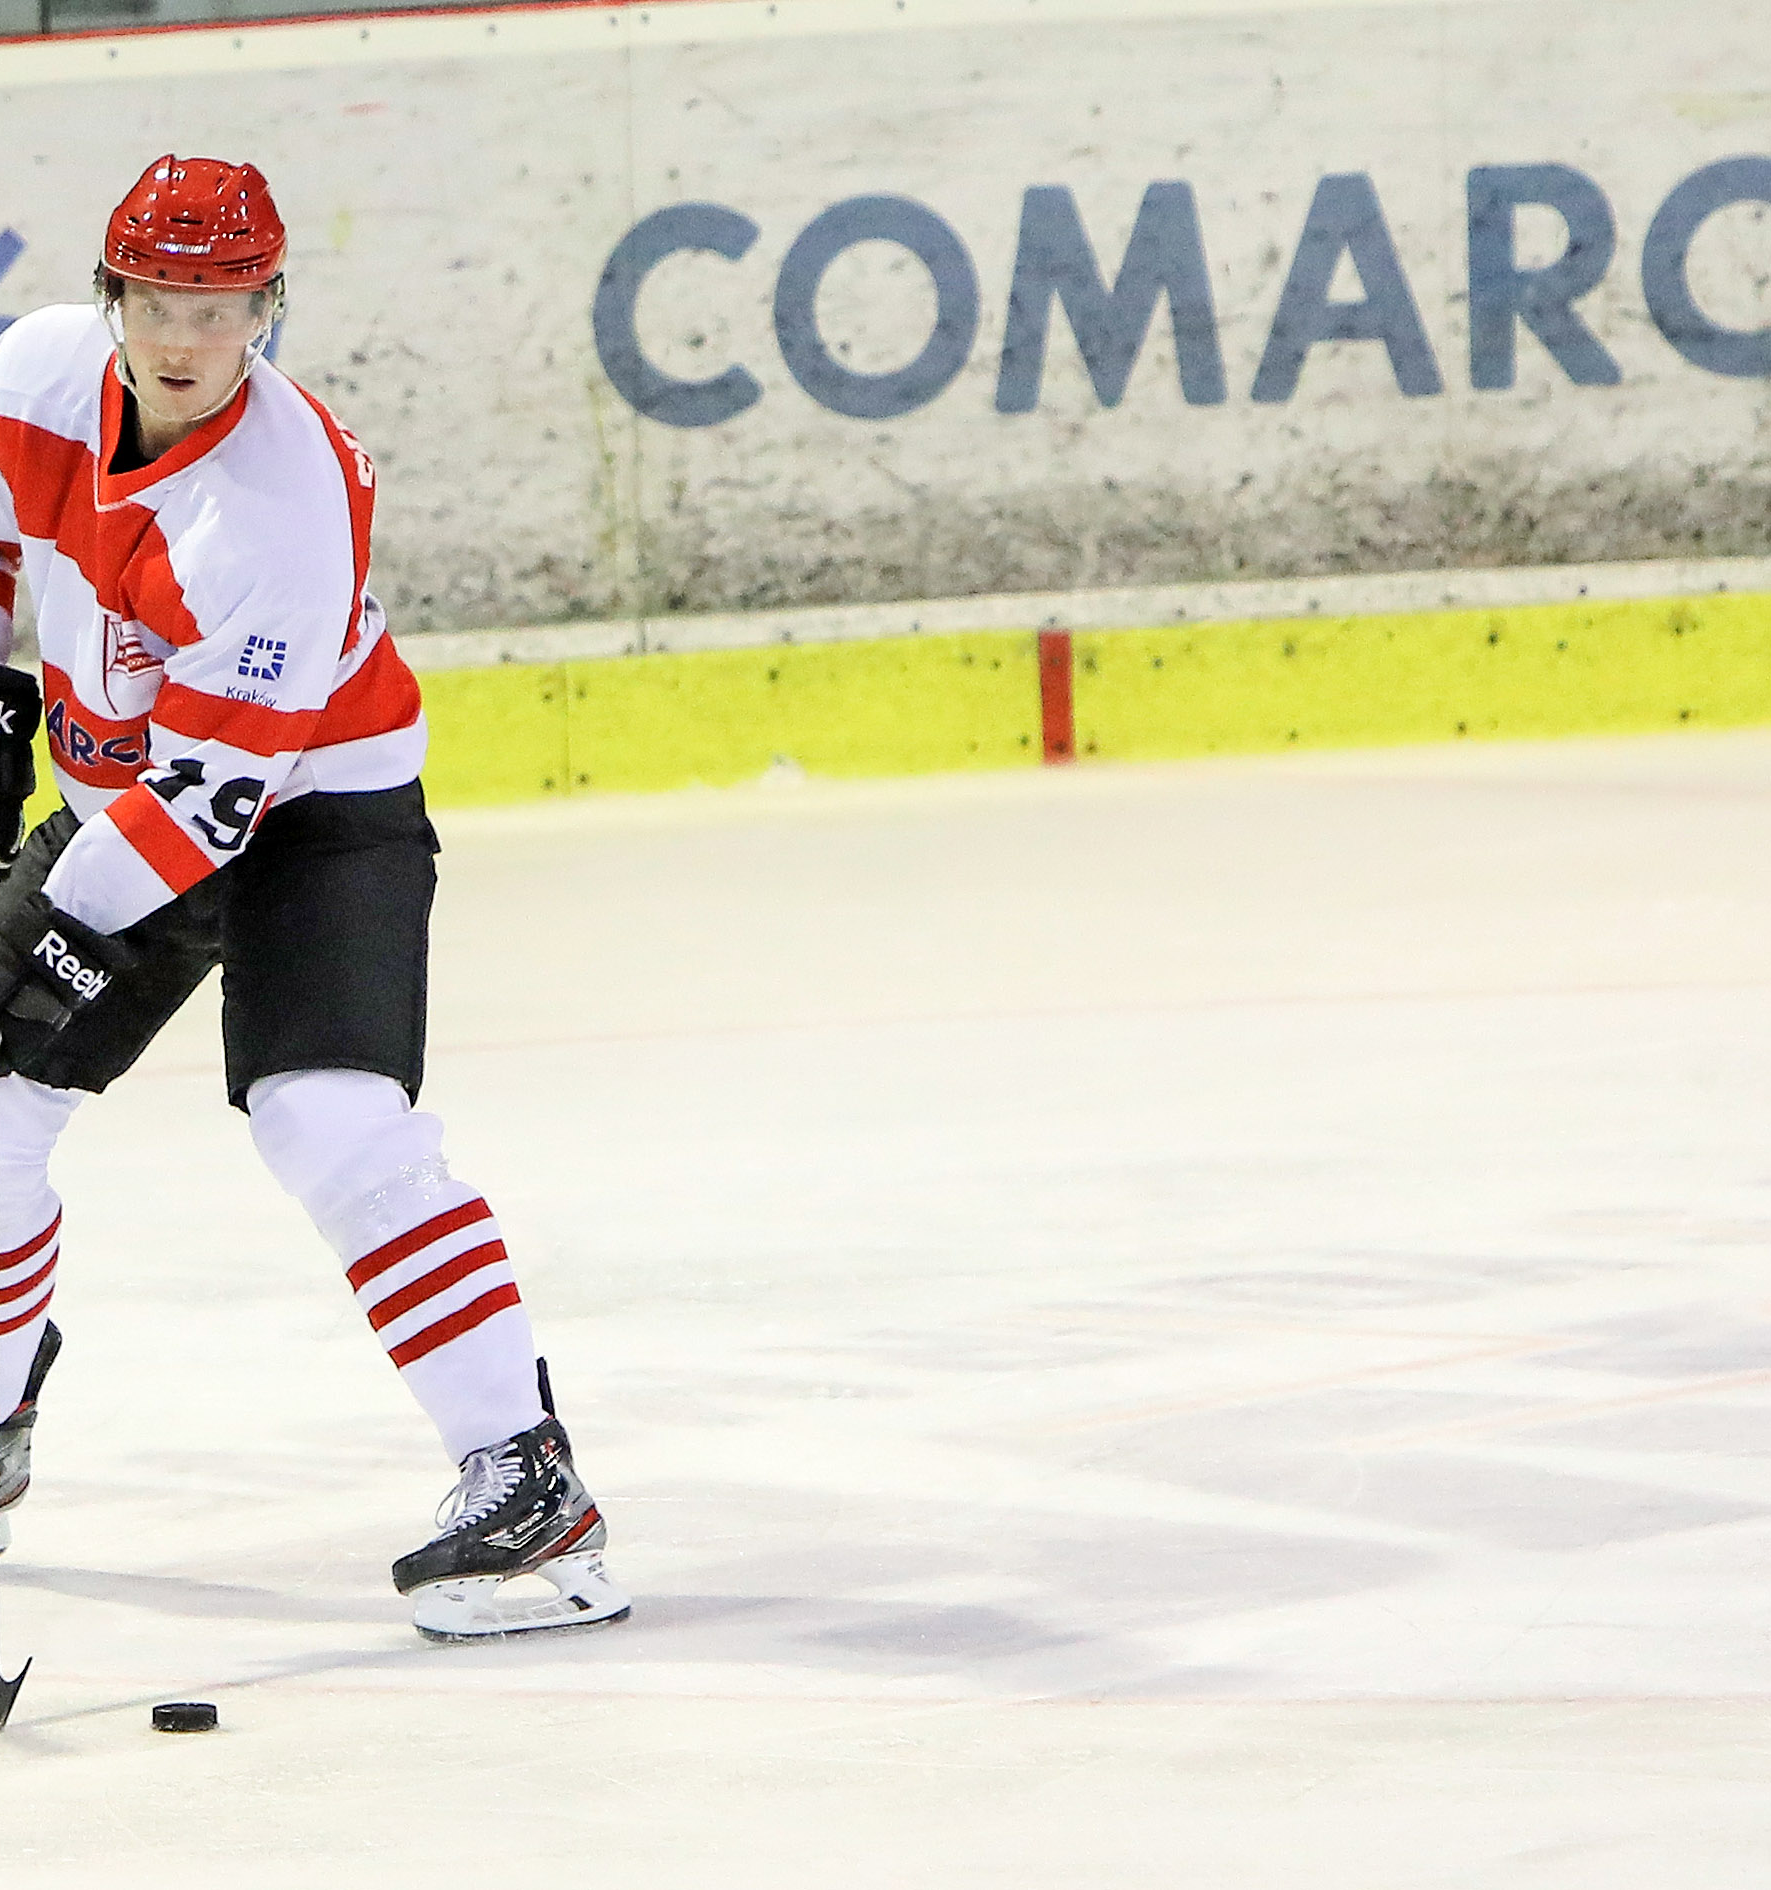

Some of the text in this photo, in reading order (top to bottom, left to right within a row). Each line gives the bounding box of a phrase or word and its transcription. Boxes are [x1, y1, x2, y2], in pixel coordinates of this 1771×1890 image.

[592, 154, 1771, 428] COMARC
[46, 698, 152, 768] ARC
[226, 686, 277, 708] Kraków
[144, 758, 266, 850] 19
